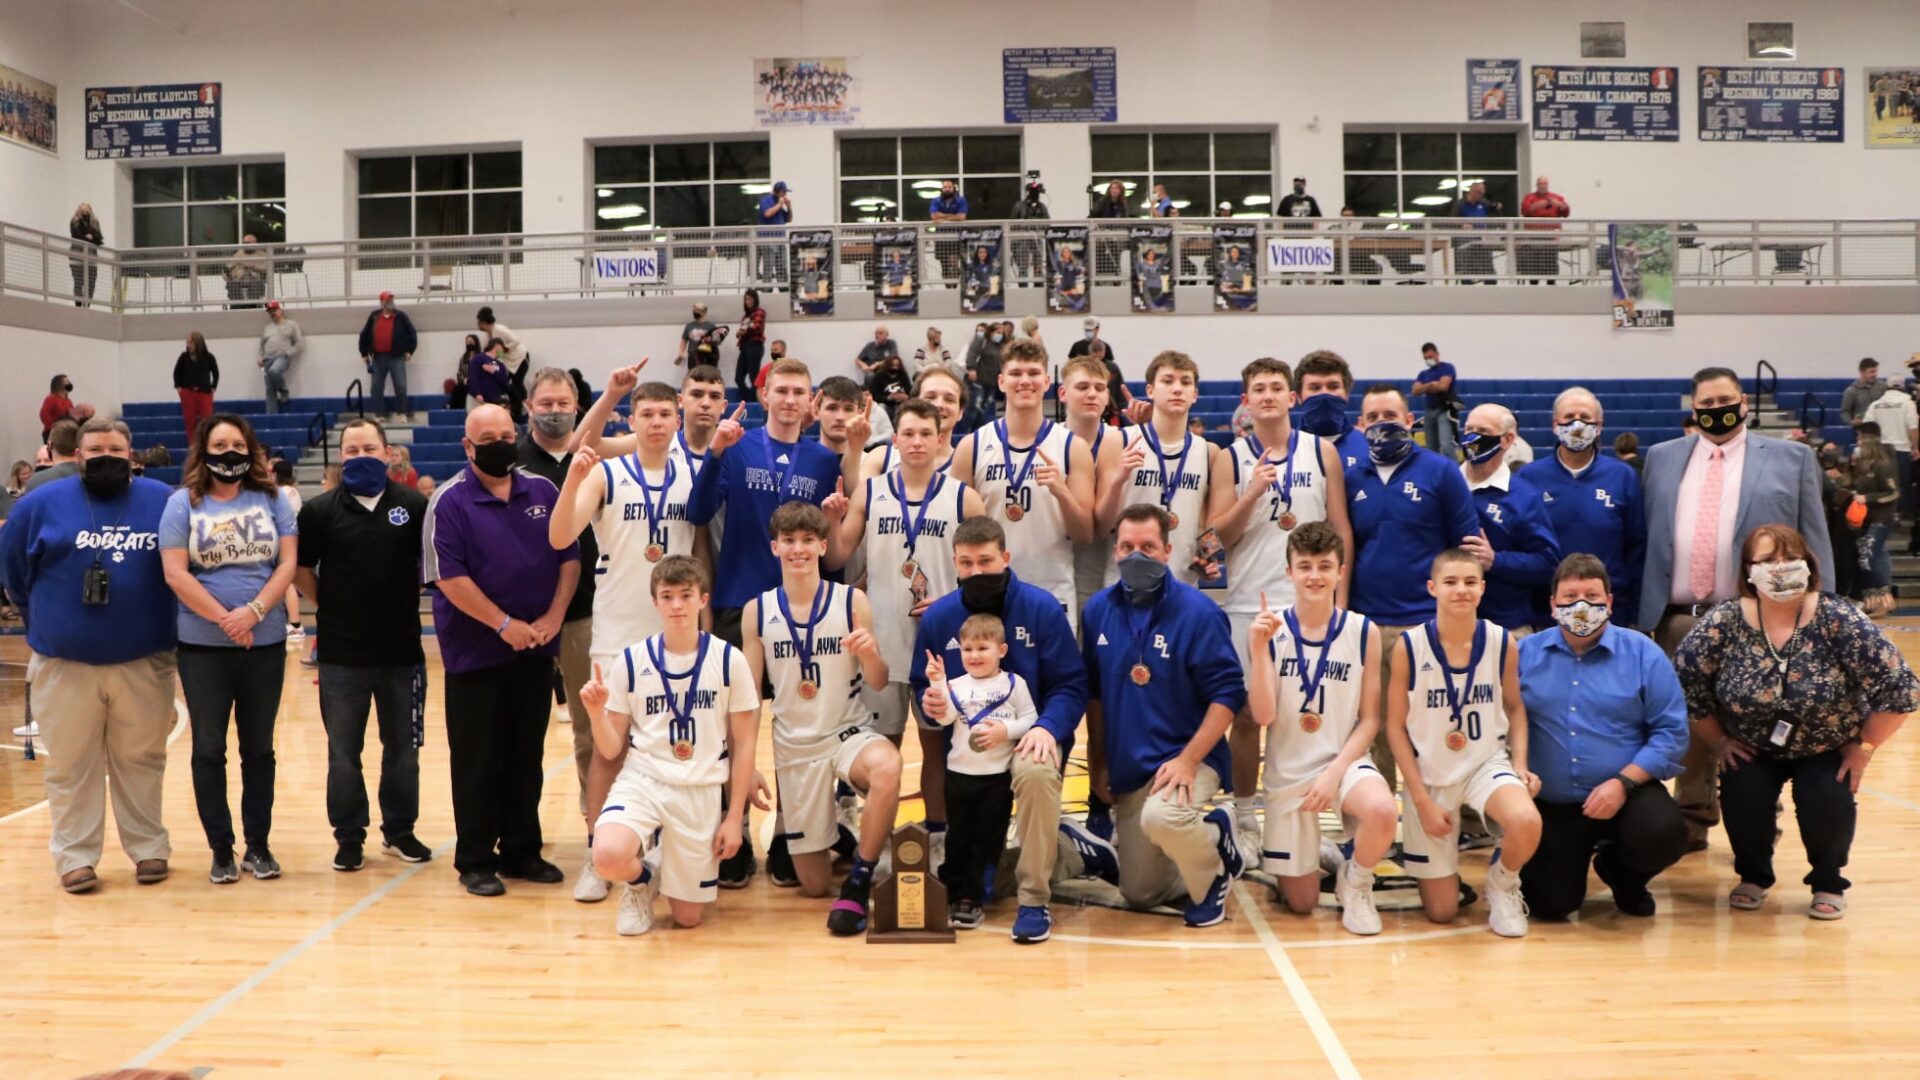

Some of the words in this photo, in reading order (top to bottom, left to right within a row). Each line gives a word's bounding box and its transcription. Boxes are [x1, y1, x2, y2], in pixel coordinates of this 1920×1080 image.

[1558, 71, 1584, 85] BETSY
[1586, 71, 1612, 85] LAYNE
[1613, 72, 1649, 86] BOBCATS
[1656, 69, 1669, 89] 1
[1727, 70, 1752, 84] BETSY
[1754, 70, 1780, 84] LAYNE
[1781, 71, 1818, 85] BOBCATS
[1826, 70, 1837, 88] 1
[107, 93, 131, 105] BETSY
[133, 92, 158, 104] LAYNE
[160, 90, 198, 102] LADYCATS
[204, 86, 215, 104] 1
[1555, 90, 1603, 103] REGIONAL
[1606, 91, 1647, 104] CHAMPS
[1723, 87, 1770, 99] REGIONAL
[1772, 88, 1814, 100] CHAMPS
[107, 109, 151, 122] REGIONAL
[153, 107, 192, 120] CHAMPS
[1271, 244, 1332, 266] VISITORS
[596, 257, 656, 279] VISITORS
[1006, 485, 1031, 513] 50
[1403, 481, 1422, 501] BL
[1595, 488, 1615, 507] BL
[1486, 503, 1503, 523] BL
[75, 529, 158, 551] BOBCATS
[225, 542, 272, 560] Bobcats
[1015, 626, 1035, 647] BL
[1153, 634, 1170, 658] BL
[1299, 685, 1325, 714] 21
[1449, 710, 1481, 741] 20
